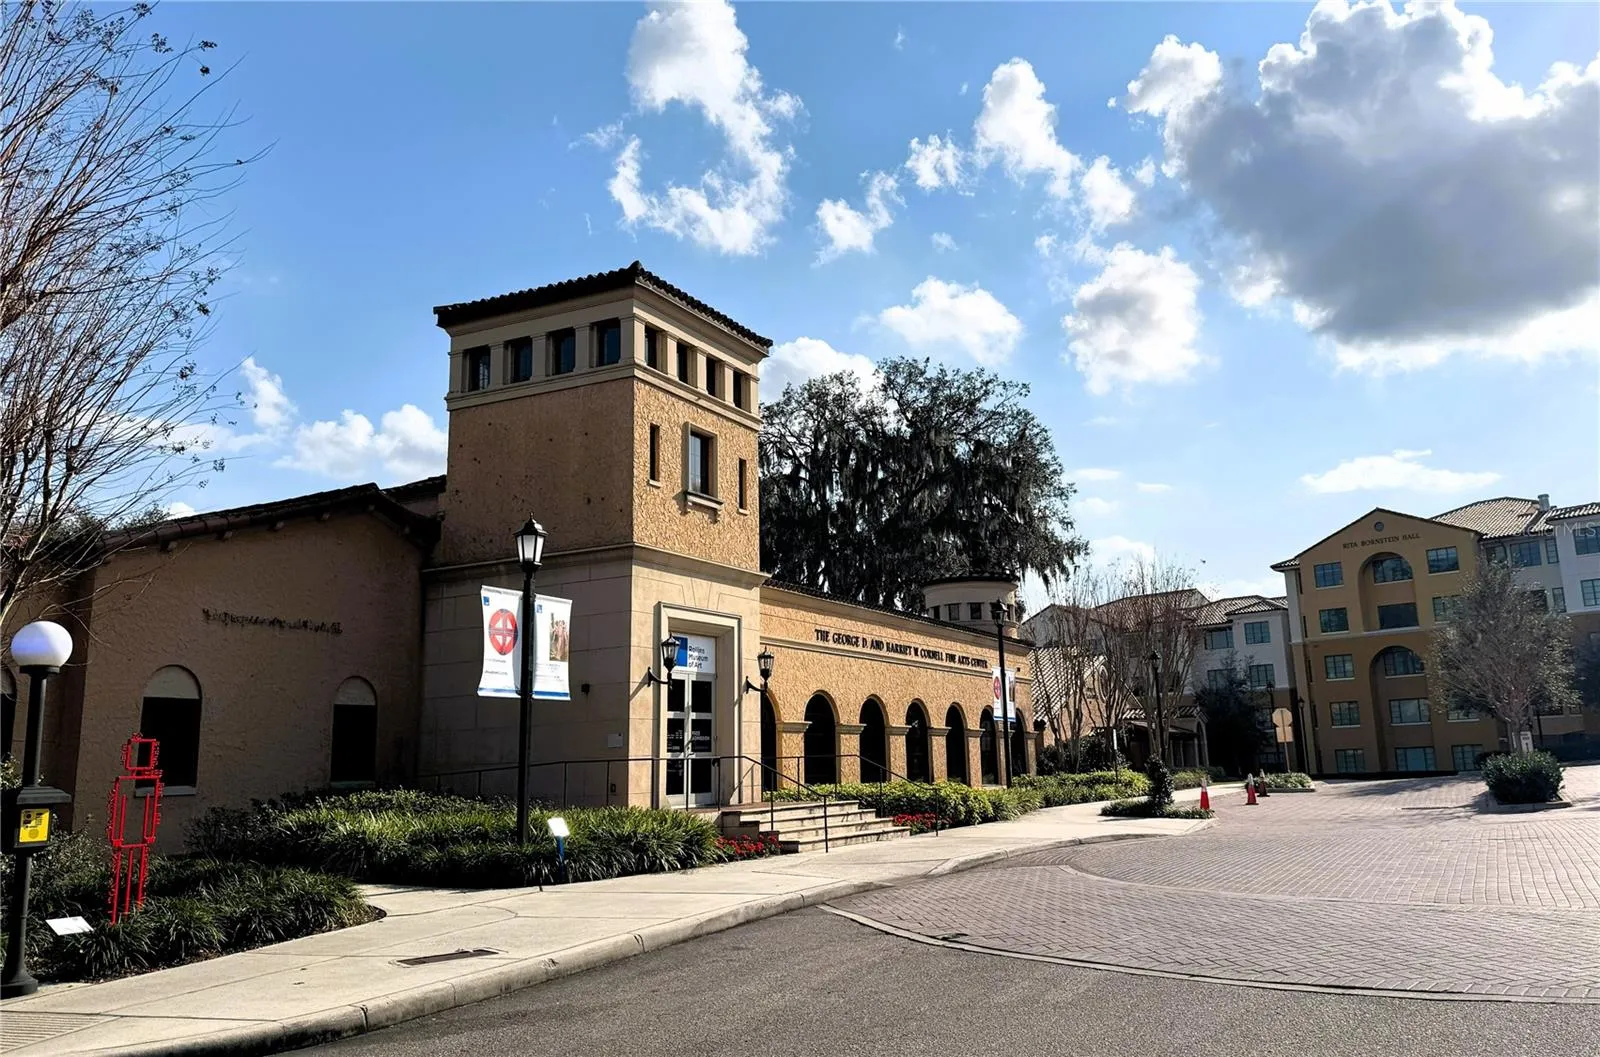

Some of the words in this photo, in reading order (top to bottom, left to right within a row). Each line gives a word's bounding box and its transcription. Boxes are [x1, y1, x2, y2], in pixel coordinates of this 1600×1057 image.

[1361, 536, 1400, 547] BORNSTEIN
[1402, 533, 1420, 541] HALL
[688, 645, 705, 654] Rollins
[815, 629, 830, 643] THE
[832, 632, 860, 647] GEORGE
[862, 637, 868, 649] D.
[870, 638, 884, 651] AND
[886, 642, 912, 656] HARRIET
[920, 648, 944, 661] CORNELL
[945, 653, 956, 664] FINE
[957, 655, 970, 666] ARTS
[971, 658, 988, 668] CENTER
[688, 653, 709, 662] Museum
